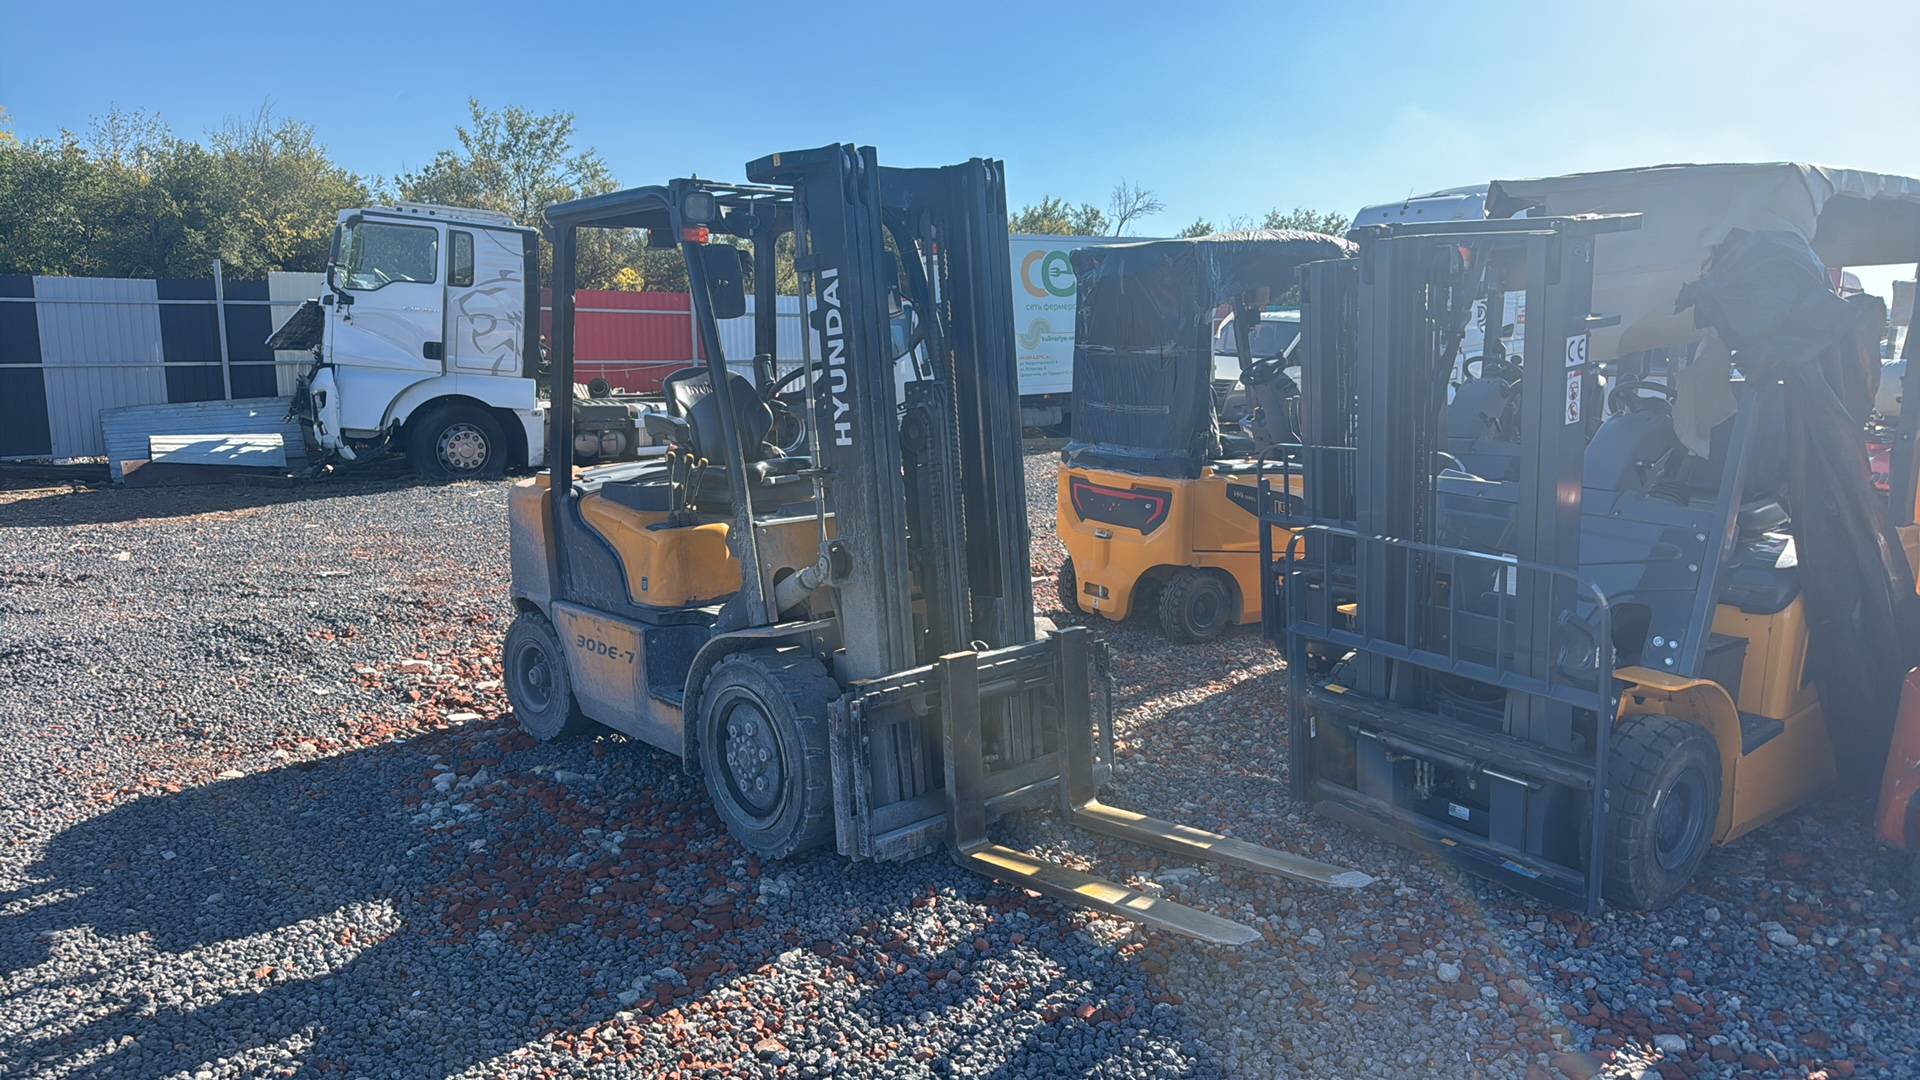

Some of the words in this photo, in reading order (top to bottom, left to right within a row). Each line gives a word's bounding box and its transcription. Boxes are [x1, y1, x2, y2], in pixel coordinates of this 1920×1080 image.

[821, 267, 853, 447] HYUNDAI
[1567, 338, 1585, 362] CE
[576, 634, 636, 665] 30DE-7
